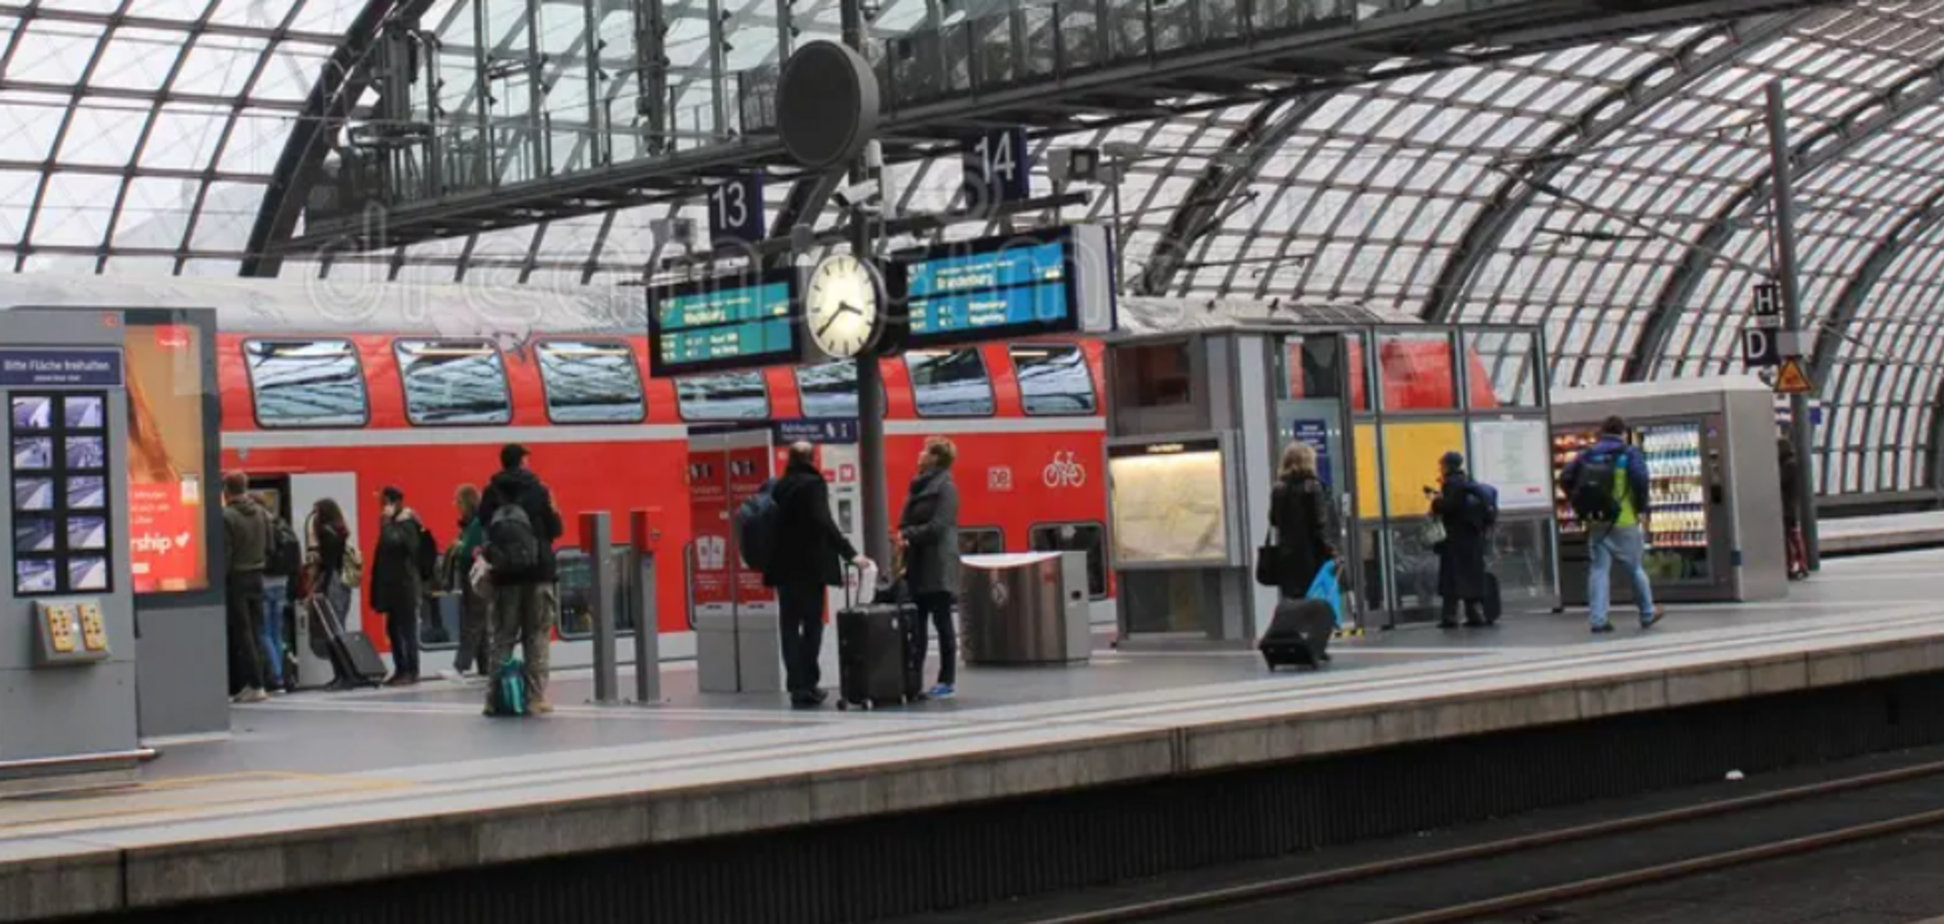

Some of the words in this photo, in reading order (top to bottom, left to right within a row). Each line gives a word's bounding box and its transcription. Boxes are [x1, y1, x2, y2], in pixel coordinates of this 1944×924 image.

[974, 131, 1016, 182] 14
[711, 181, 748, 229] 13
[1757, 287, 1774, 311] H
[1747, 329, 1768, 359] D
[4, 359, 27, 371] Bitte
[130, 531, 172, 554] rship
